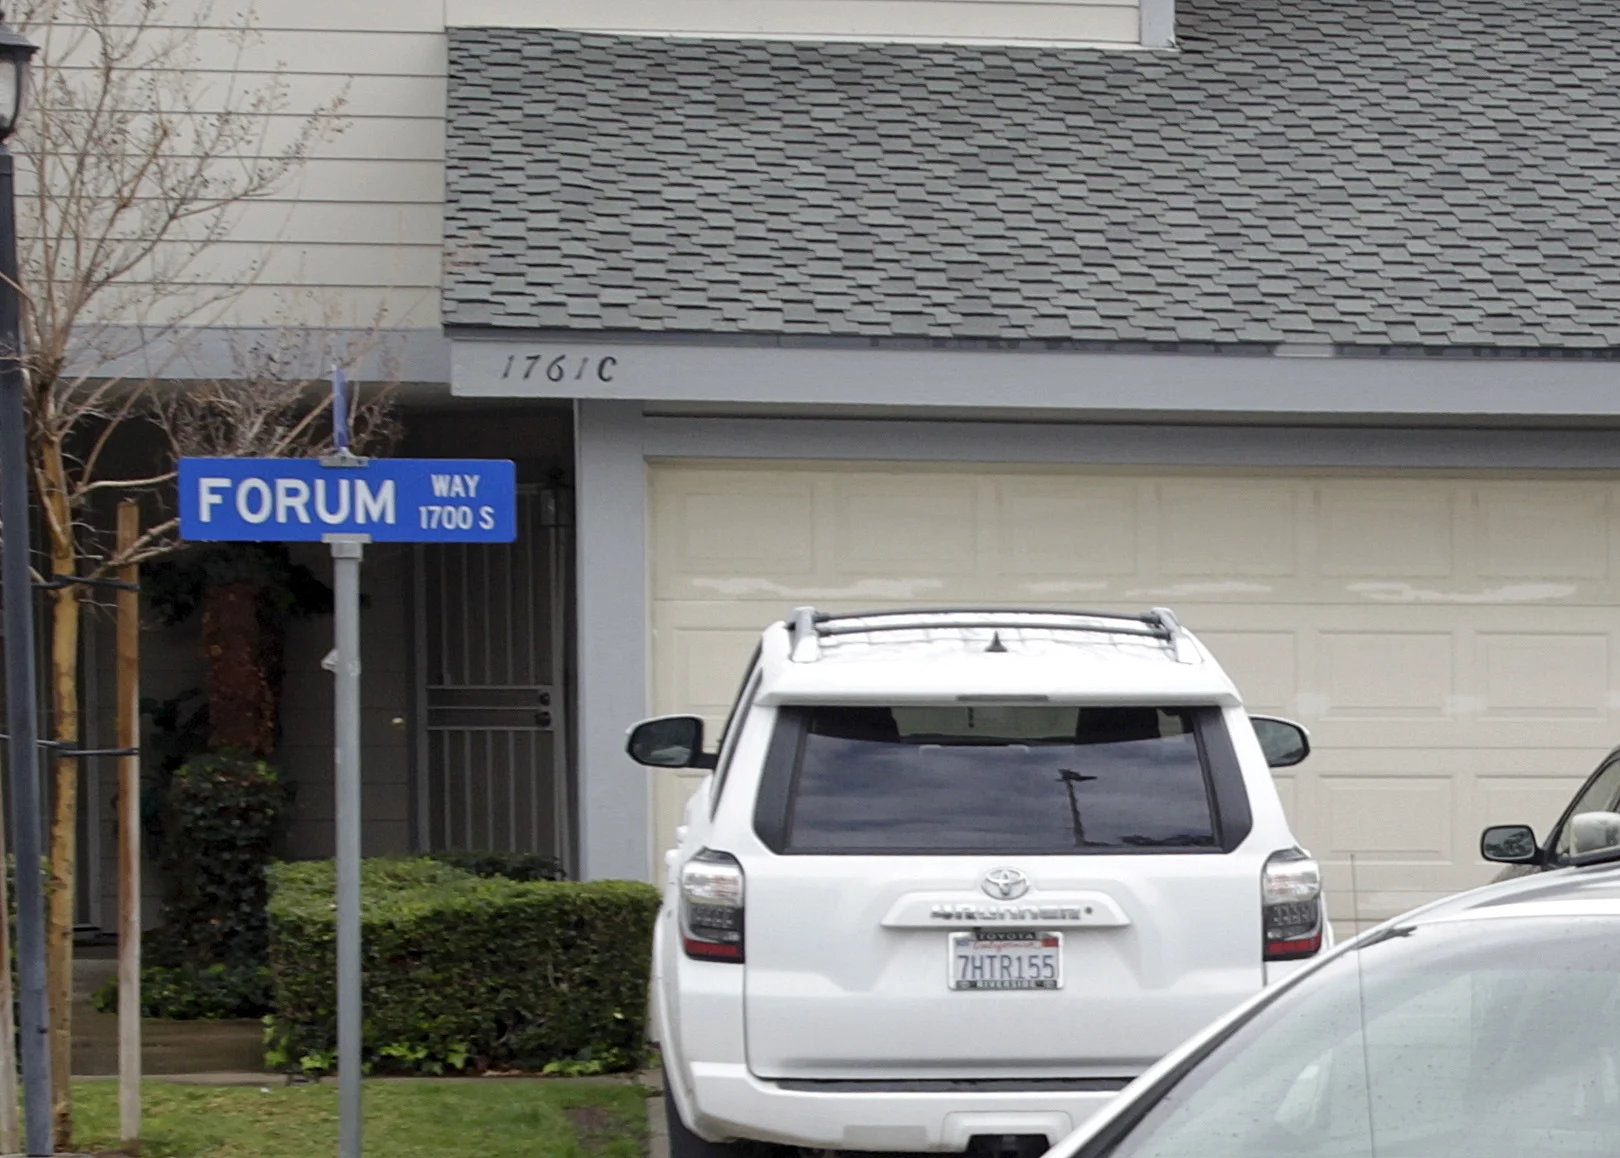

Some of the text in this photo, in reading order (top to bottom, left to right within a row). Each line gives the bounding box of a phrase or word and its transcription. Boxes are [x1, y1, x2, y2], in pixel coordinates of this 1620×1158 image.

[431, 474, 481, 499] WAY
[199, 477, 396, 525] FORUM
[419, 505, 495, 530] 1700 S
[979, 931, 1035, 940] TOYOTA
[957, 954, 1055, 979] 7HTR155
